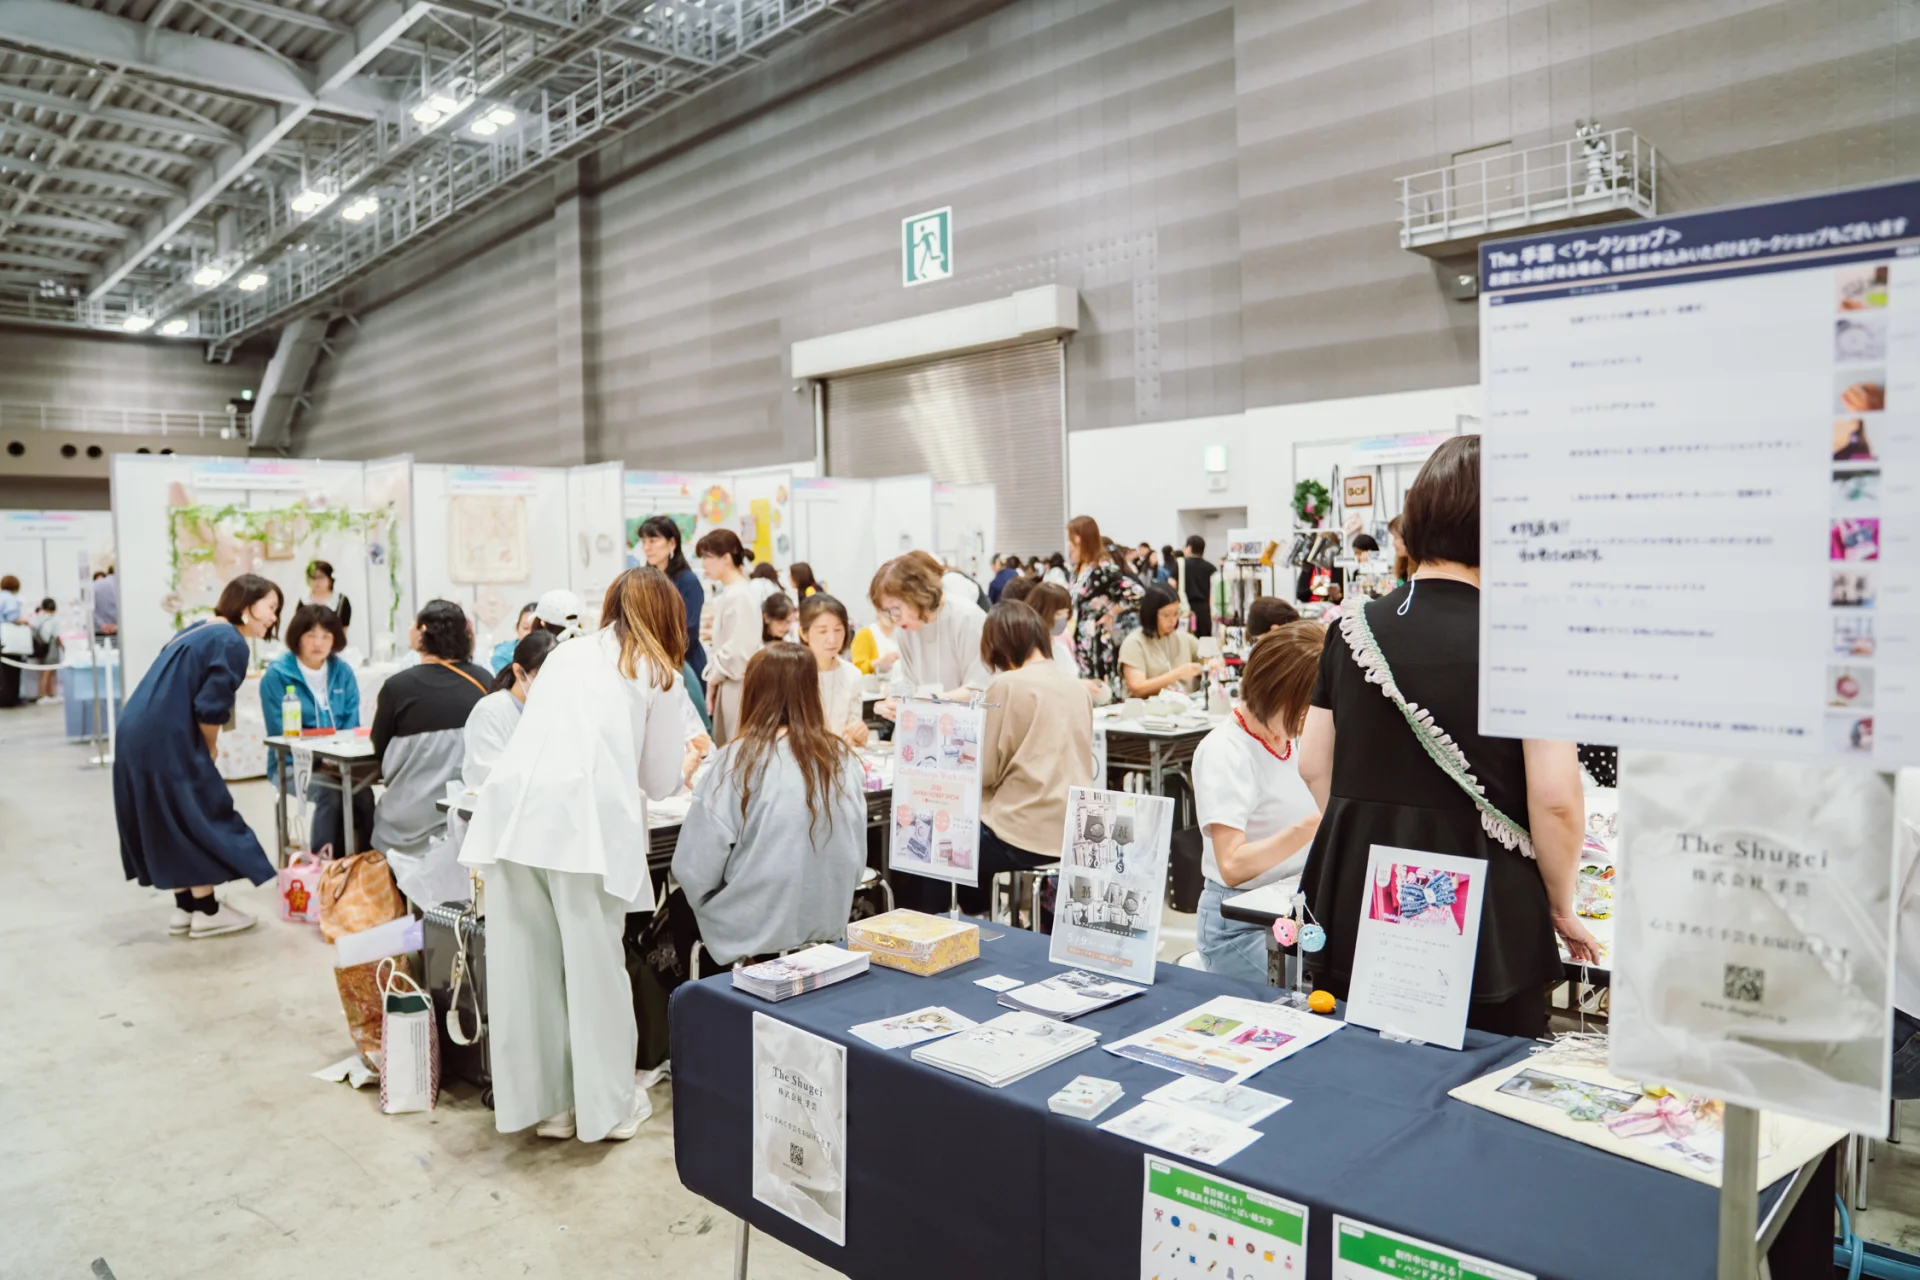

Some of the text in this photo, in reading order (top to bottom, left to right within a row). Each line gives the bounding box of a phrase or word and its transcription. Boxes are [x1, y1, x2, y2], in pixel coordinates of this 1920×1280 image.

[1489, 250, 1519, 269] The
[1676, 832, 1829, 870] The Shugei
[1692, 868, 1765, 890] 株式会社
[772, 1066, 824, 1097] The Shugei
[778, 1087, 803, 1106] 株式会社
